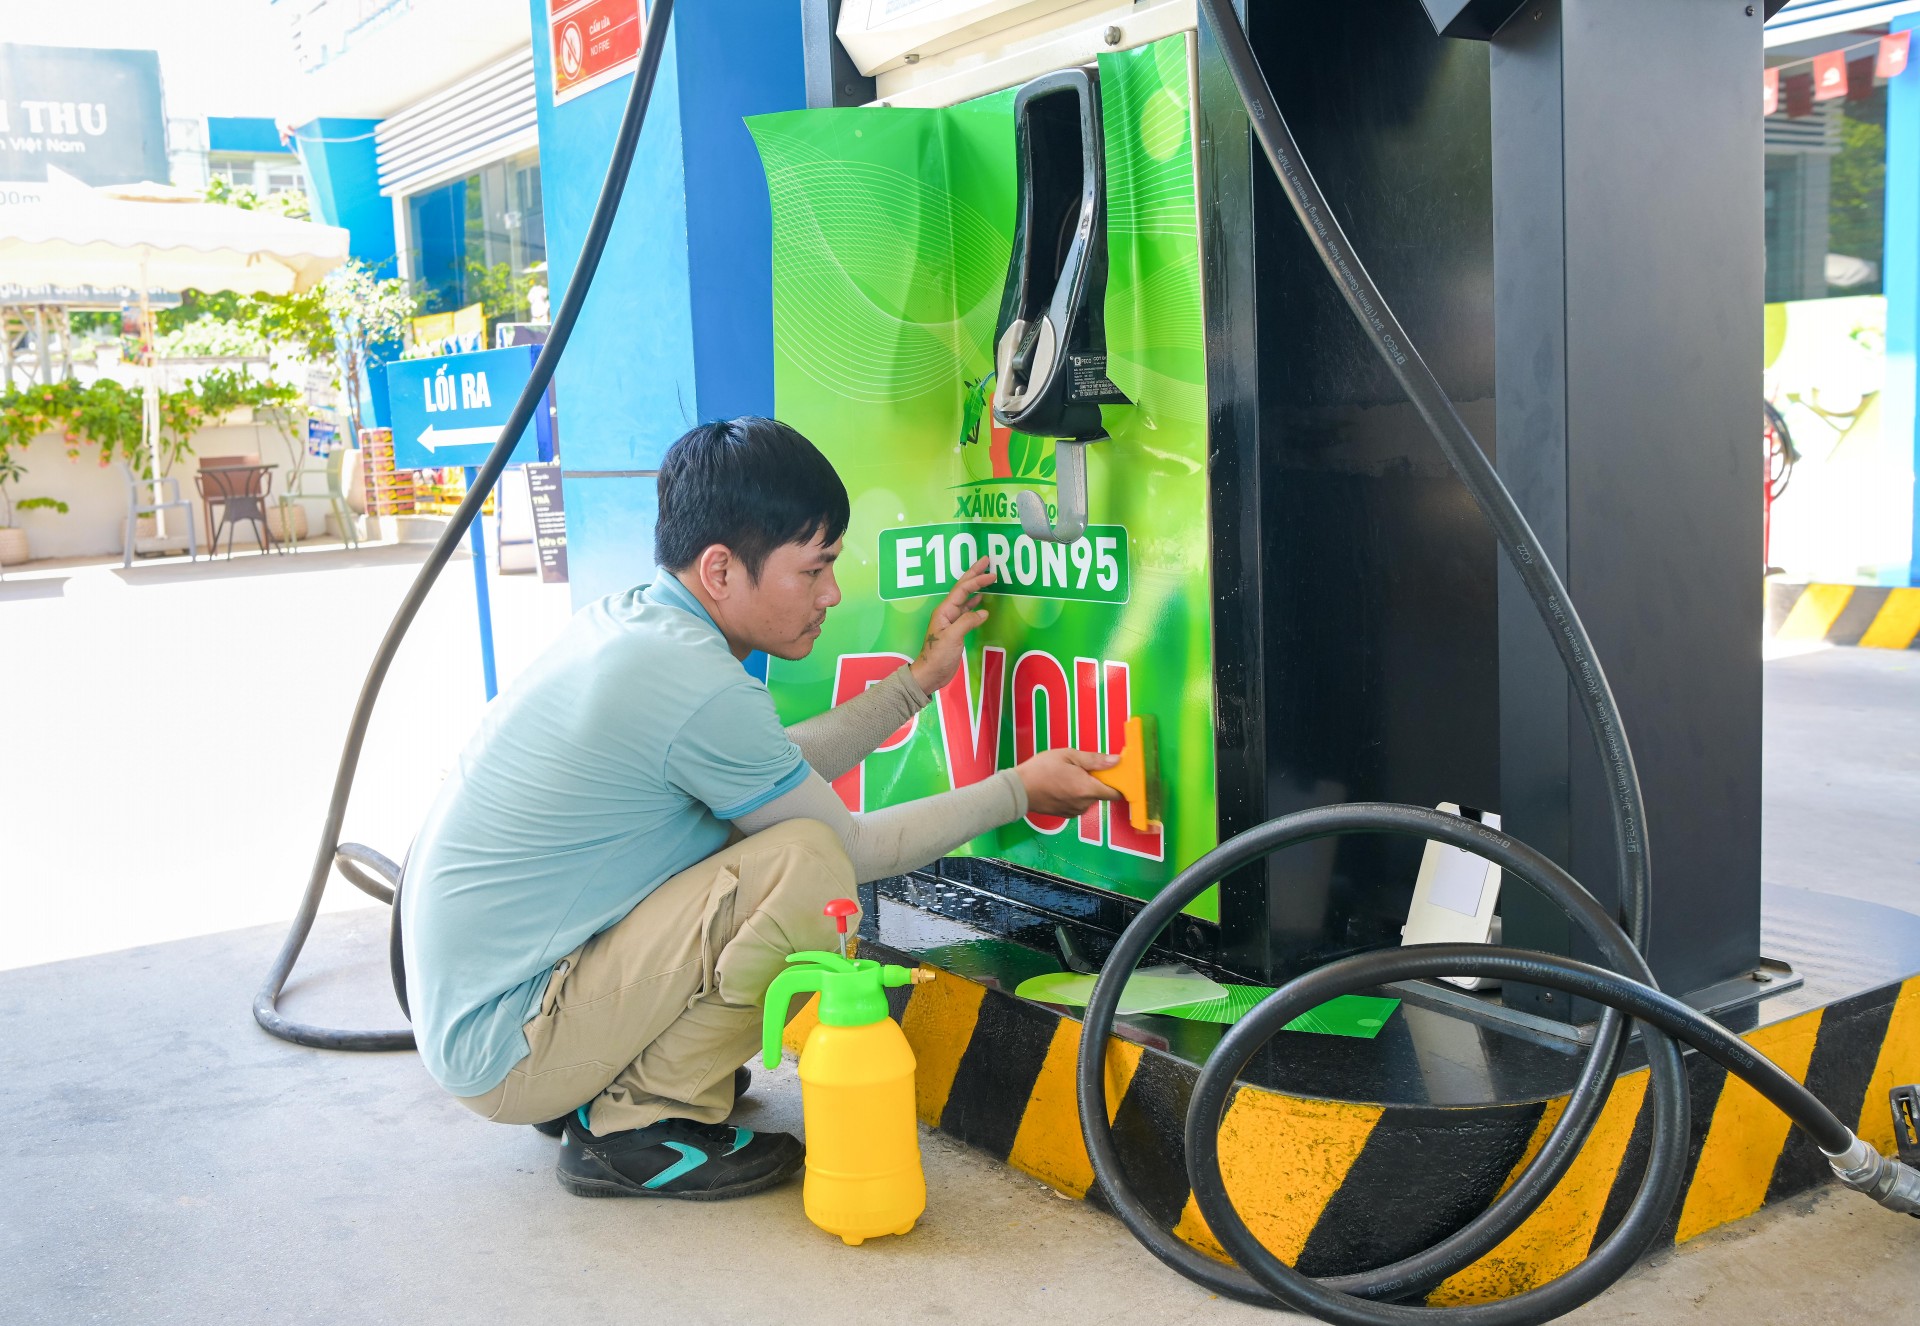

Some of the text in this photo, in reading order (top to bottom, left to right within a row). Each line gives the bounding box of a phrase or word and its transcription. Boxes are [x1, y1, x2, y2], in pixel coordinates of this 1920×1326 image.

[590, 38, 610, 56] NO FIRE
[20, 100, 107, 136] THU
[1252, 98, 1266, 120] 4Q22
[9, 137, 42, 154] Việt
[46, 138, 86, 153] Nam
[1291, 176, 1308, 209] Pressure
[1308, 206, 1328, 238] Working
[1327, 240, 1341, 262] Hose
[1338, 259, 1359, 291] Gasoline
[1383, 334, 1402, 359] PECO
[423, 363, 492, 413] LỐI RA
[953, 488, 1008, 519] XĂNG
[896, 532, 978, 589] E10
[1564, 626, 1584, 662] Pressure
[1596, 701, 1608, 724] Hose
[831, 646, 1164, 862] PVOIL
[1604, 725, 1619, 761] Gasoline
[1377, 1279, 1404, 1294] PECO
[1454, 1232, 1488, 1260] Gasoline
